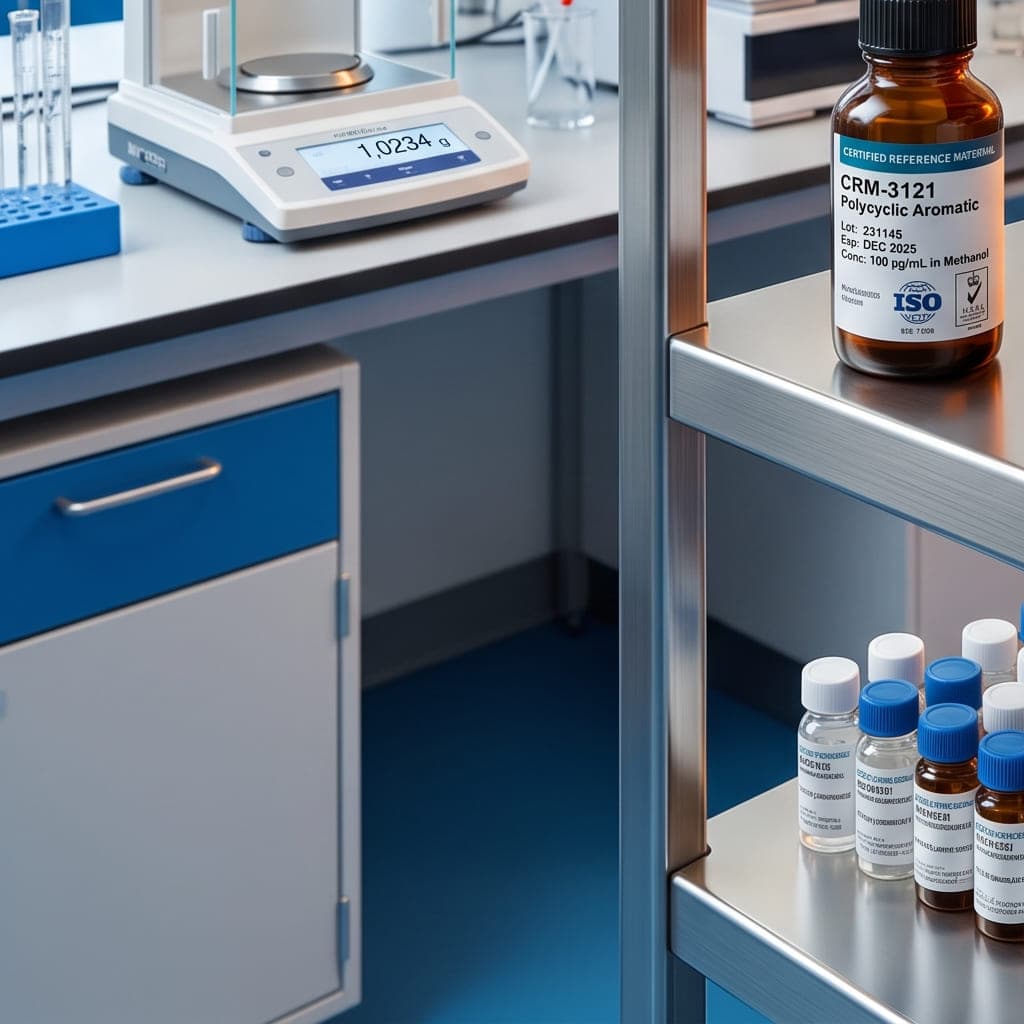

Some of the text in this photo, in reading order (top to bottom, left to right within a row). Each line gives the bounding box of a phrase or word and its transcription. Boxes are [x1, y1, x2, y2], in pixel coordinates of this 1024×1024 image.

[439, 137, 452, 148] g
[843, 147, 887, 163] CERTIFIED
[889, 154, 951, 165] REFERENCE
[841, 174, 935, 199] CRM-3121
[841, 195, 979, 218] Polycyclic Aromatic
[841, 220, 902, 240] Lot: 231145
[863, 239, 887, 253] DEC
[890, 243, 917, 254] 2025
[841, 249, 866, 264] Conc:
[870, 256, 889, 267] 100
[930, 257, 941, 268] in
[944, 248, 989, 267] Methanol
[893, 293, 942, 312] ISO
